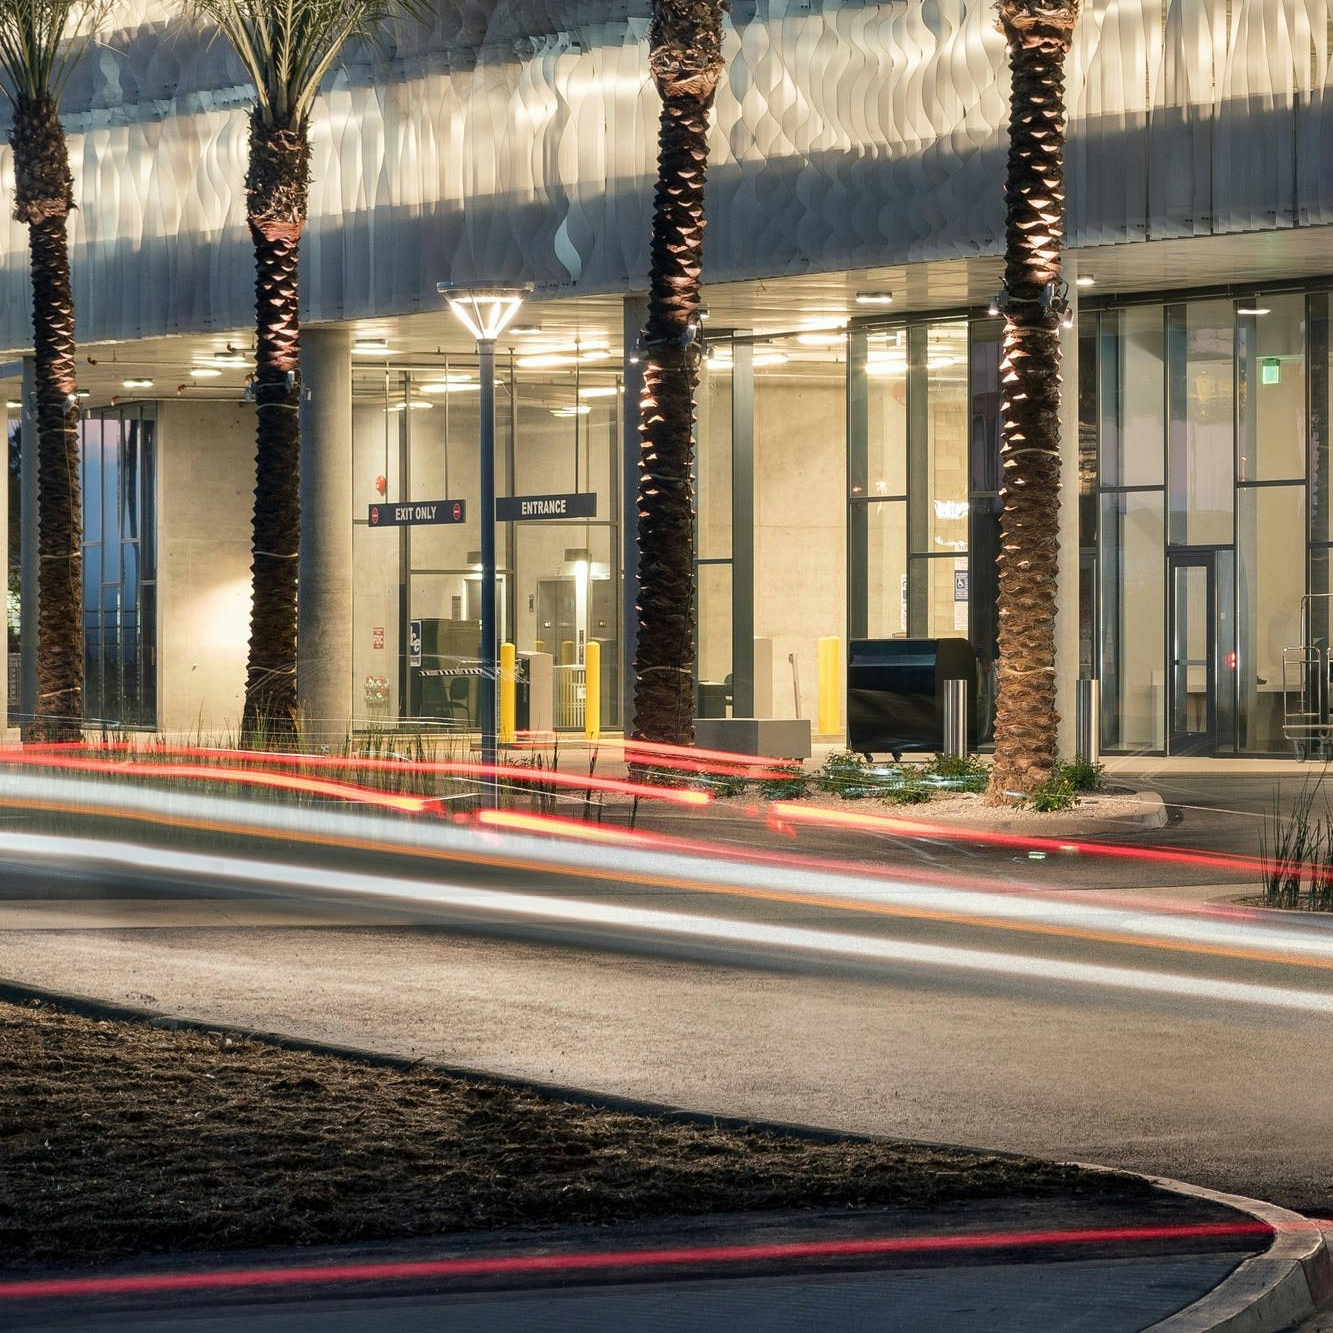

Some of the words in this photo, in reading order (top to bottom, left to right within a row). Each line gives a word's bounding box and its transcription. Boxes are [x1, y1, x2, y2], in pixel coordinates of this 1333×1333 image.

[395, 507, 414, 521] EXIT
[415, 506, 437, 520] ONLY
[521, 499, 567, 515] ENTRANCE
